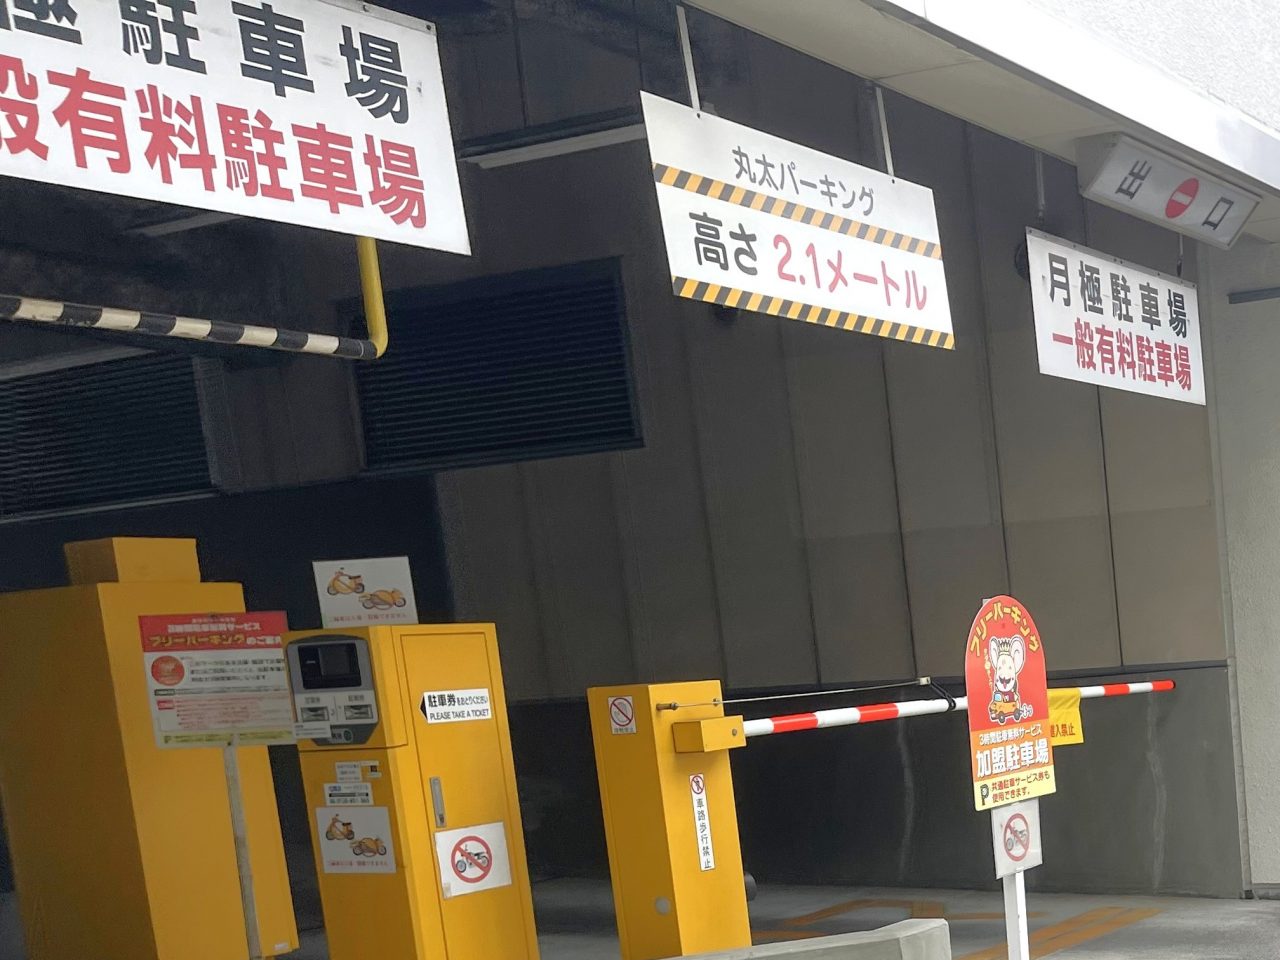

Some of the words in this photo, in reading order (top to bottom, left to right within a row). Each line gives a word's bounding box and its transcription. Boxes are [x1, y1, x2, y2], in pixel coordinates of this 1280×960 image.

[731, 145, 875, 217] 丸太パーキング
[688, 211, 758, 276] 高さ
[773, 234, 928, 311] 2.1メートル
[1048, 252, 1188, 339] 月極駐車場
[1052, 317, 1192, 391] 一般有料駐車場
[429, 711, 451, 720] PLEASE
[451, 710, 466, 719] TAKE
[471, 708, 489, 717] TICKET
[976, 737, 1049, 778] 加盟駐車場
[696, 798, 712, 869] 車路歩行禁止
